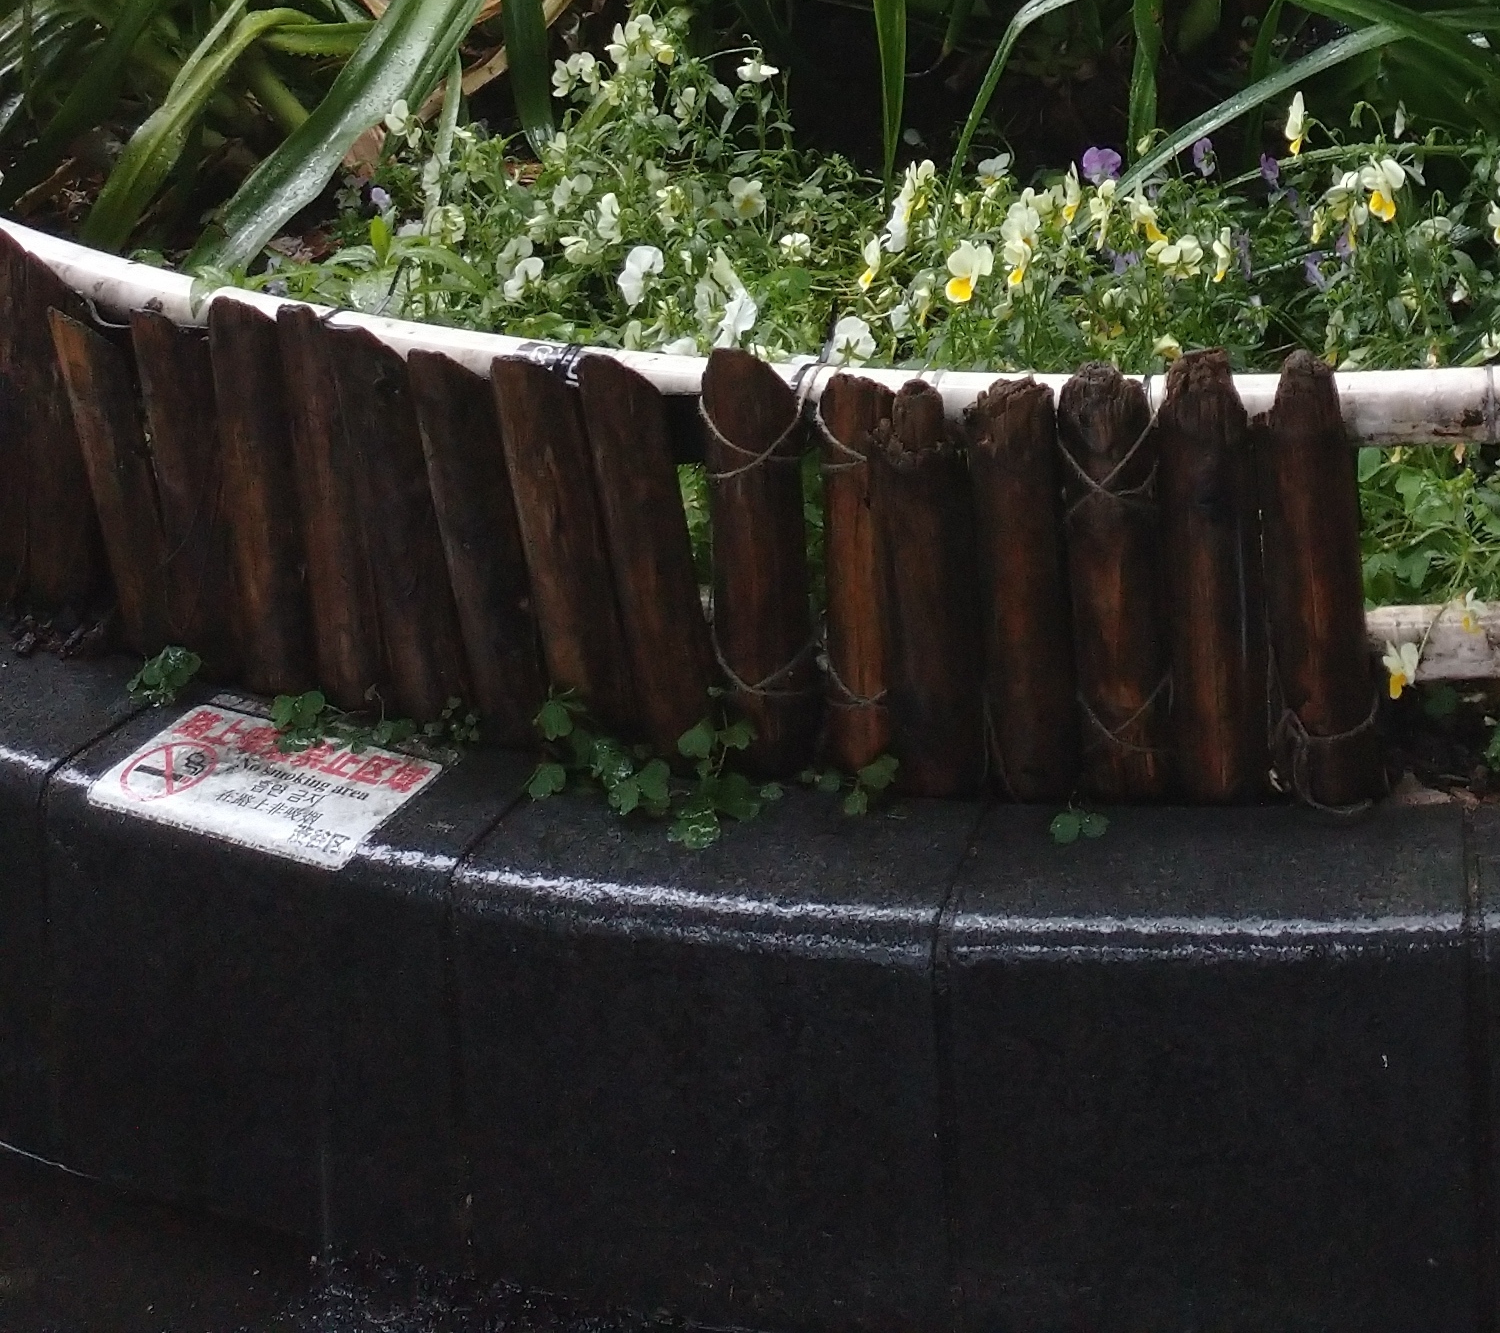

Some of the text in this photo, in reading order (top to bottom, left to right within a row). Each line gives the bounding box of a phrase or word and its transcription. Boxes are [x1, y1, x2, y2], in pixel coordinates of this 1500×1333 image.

[250, 779, 325, 807] 흡연 금지
[262, 766, 331, 792] smoking
[331, 785, 370, 801] area
